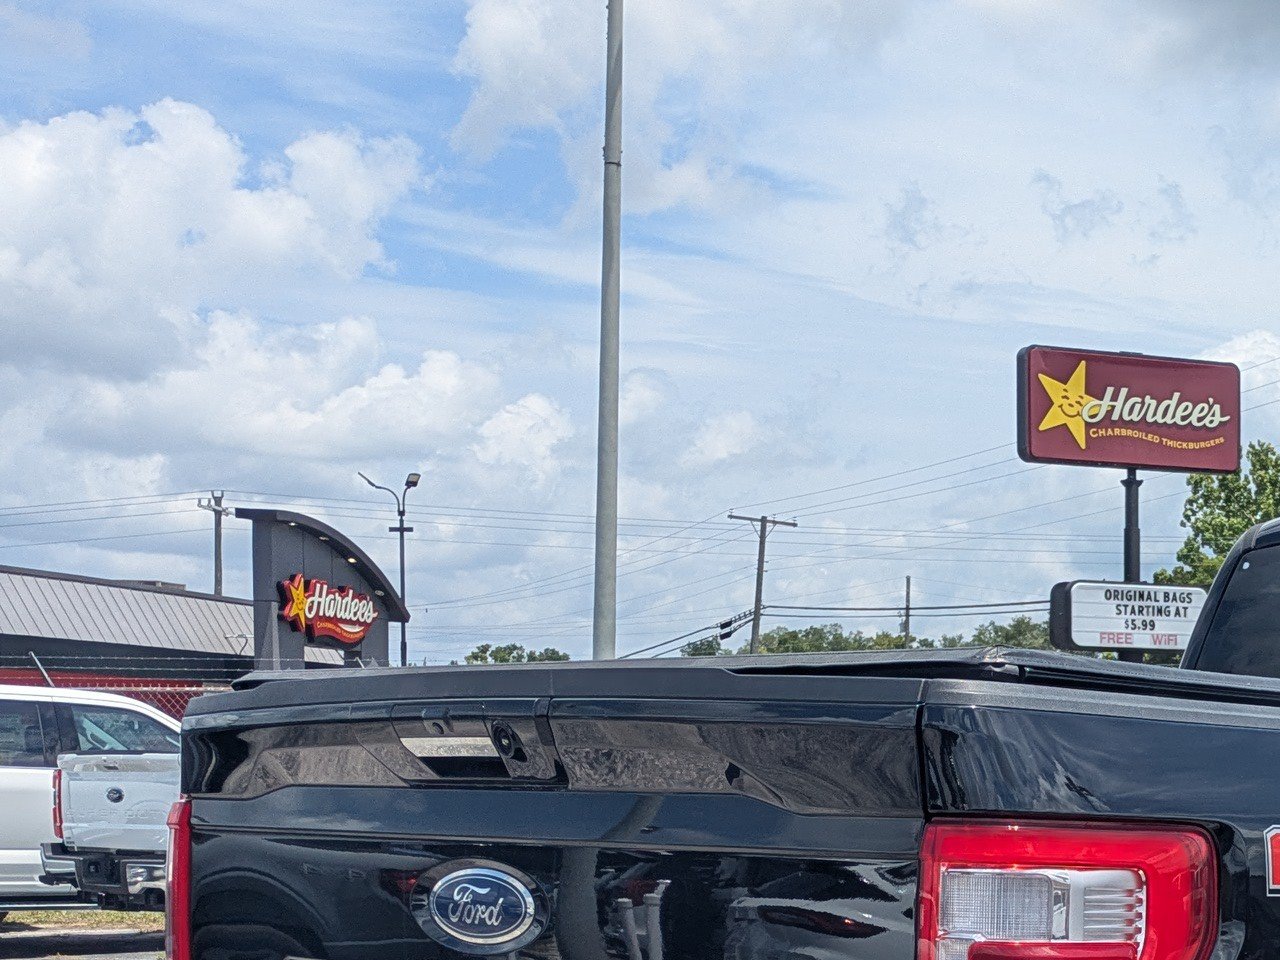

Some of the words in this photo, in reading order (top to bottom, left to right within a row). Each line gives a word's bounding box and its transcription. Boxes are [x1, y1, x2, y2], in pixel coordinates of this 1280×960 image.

[1081, 386, 1231, 428] Hardee's
[1089, 428, 1160, 443] CHARBROILED
[1161, 437, 1225, 450] THICKBURGERS
[304, 583, 379, 623] Hardee's
[1104, 589, 1160, 602] ORIGINAL
[1163, 591, 1193, 604] BAGS
[1115, 604, 1171, 617] STARTING
[1174, 606, 1189, 618] AT
[1124, 619, 1156, 631] $5.99
[1099, 632, 1134, 645] FREE
[447, 883, 505, 927] Ford
